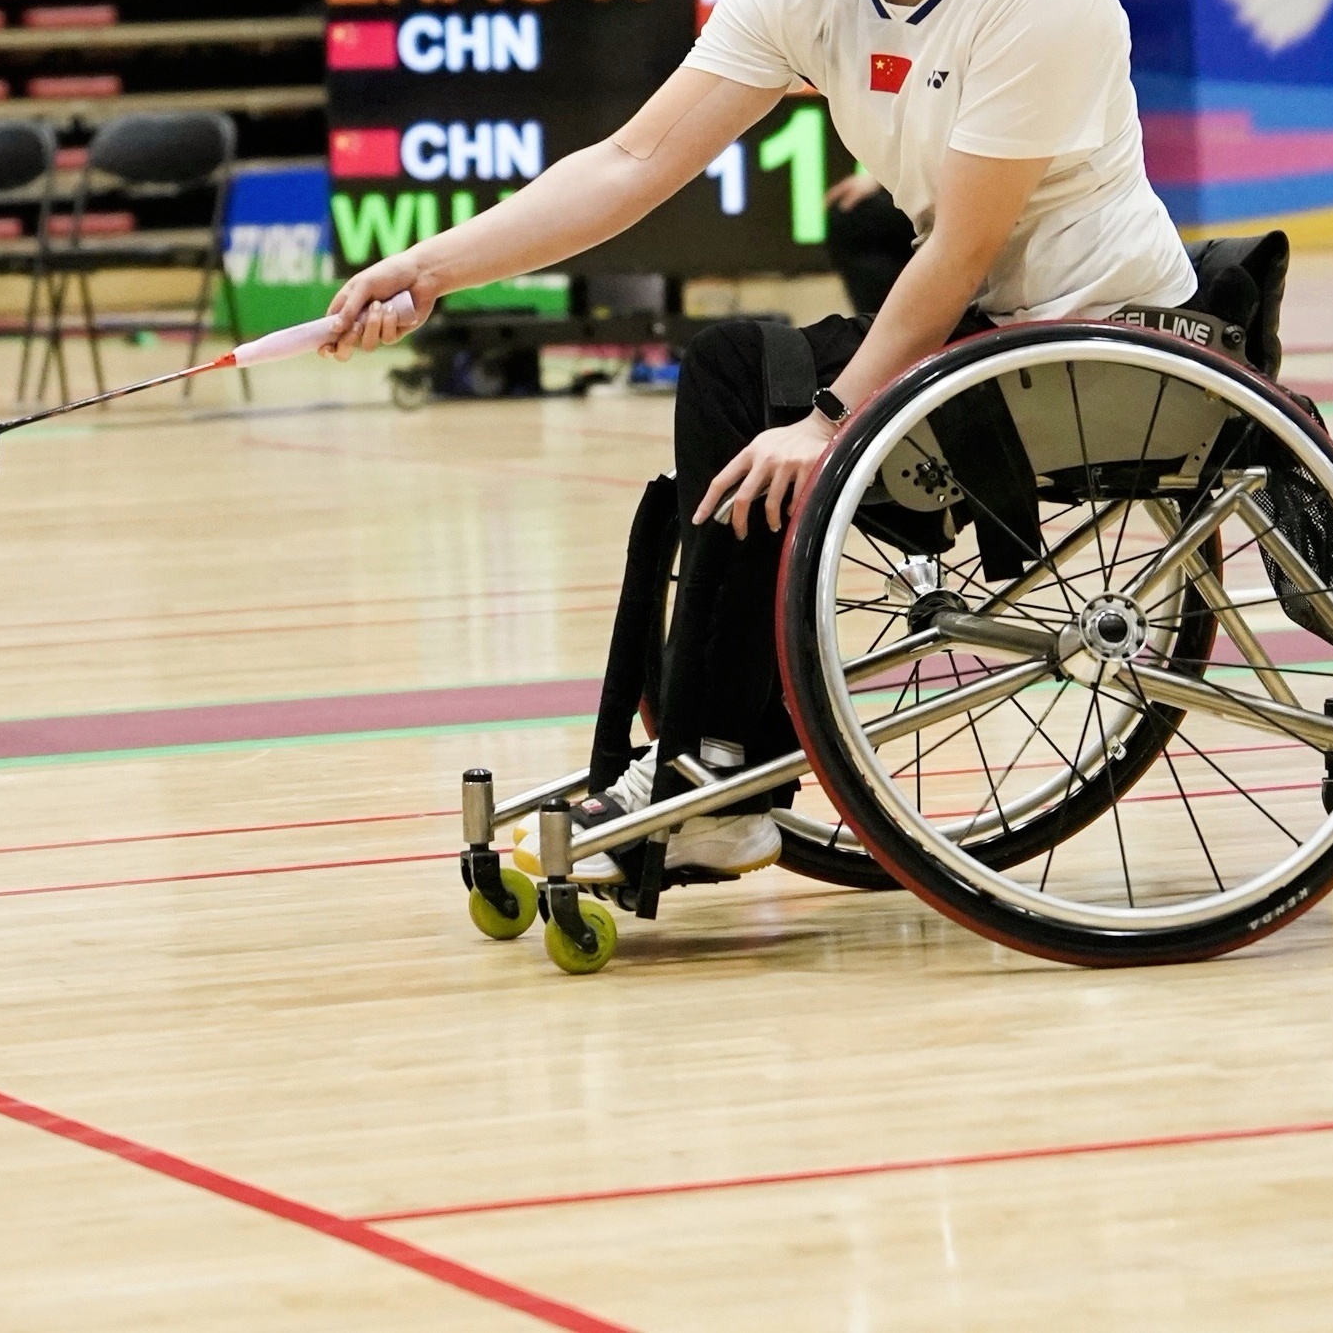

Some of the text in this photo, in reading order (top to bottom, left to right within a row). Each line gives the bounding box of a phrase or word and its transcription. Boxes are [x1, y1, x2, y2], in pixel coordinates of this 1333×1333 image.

[397, 11, 541, 74] CHN
[400, 121, 543, 181] CHN
[759, 104, 871, 246] 1
[1158, 313, 1211, 345] LINE
